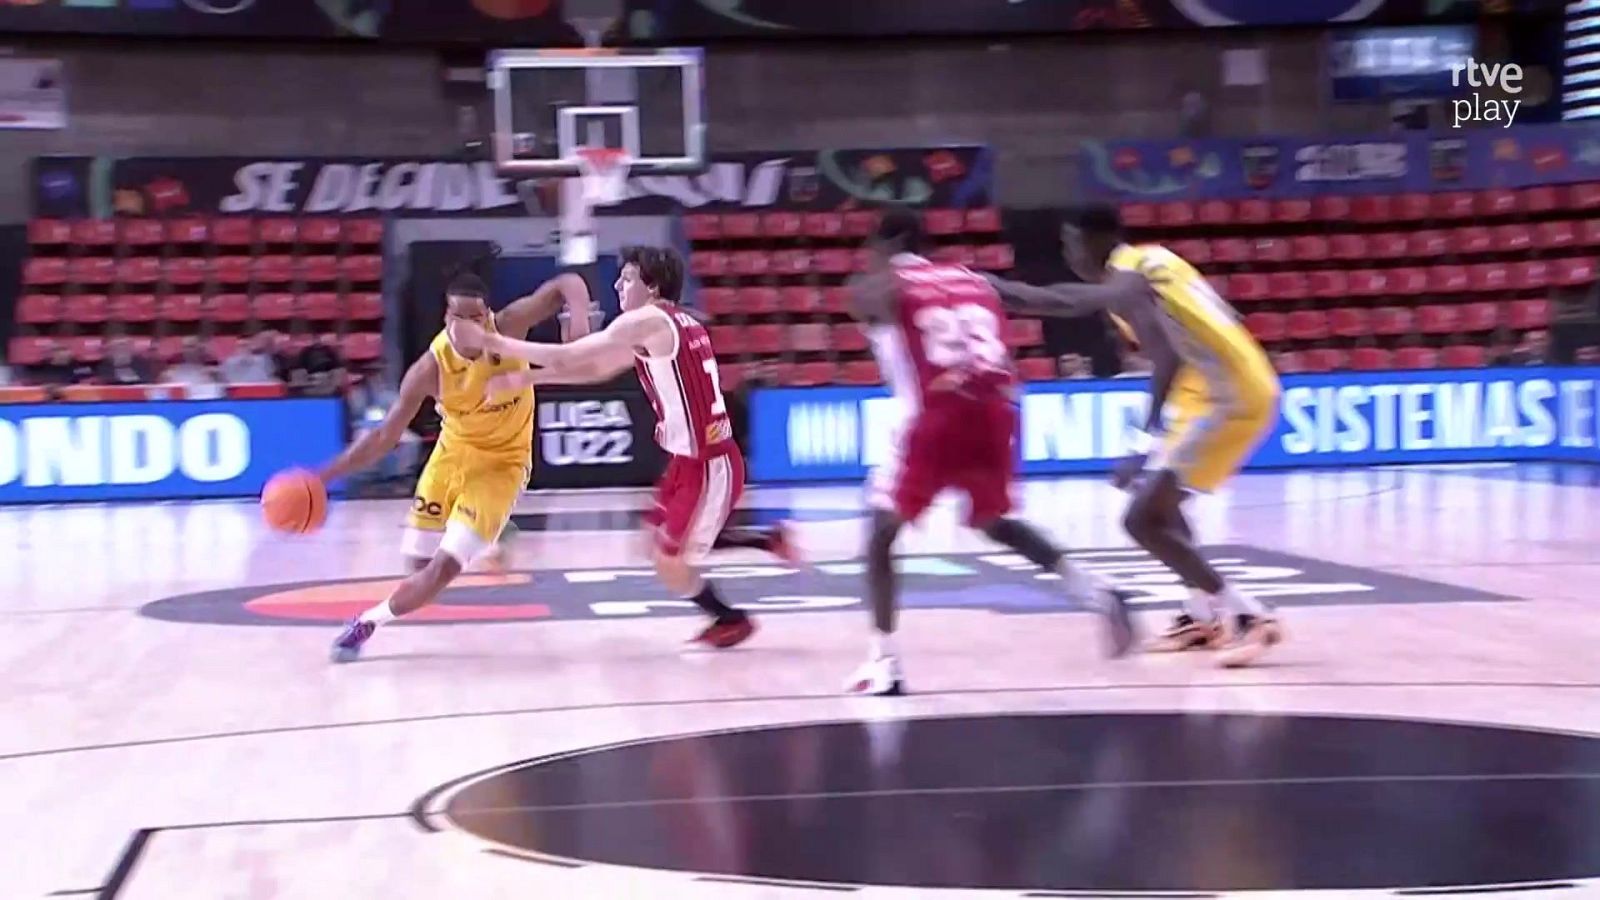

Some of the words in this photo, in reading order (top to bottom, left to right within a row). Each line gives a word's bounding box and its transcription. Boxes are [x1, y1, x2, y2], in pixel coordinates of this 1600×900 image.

[219, 162, 305, 212] SE
[303, 162, 520, 212] DECIDE
[538, 400, 634, 428] LIGA
[1281, 379, 1557, 455] SISTEMAS
[1558, 379, 1600, 448] E
[540, 430, 635, 466] U22
